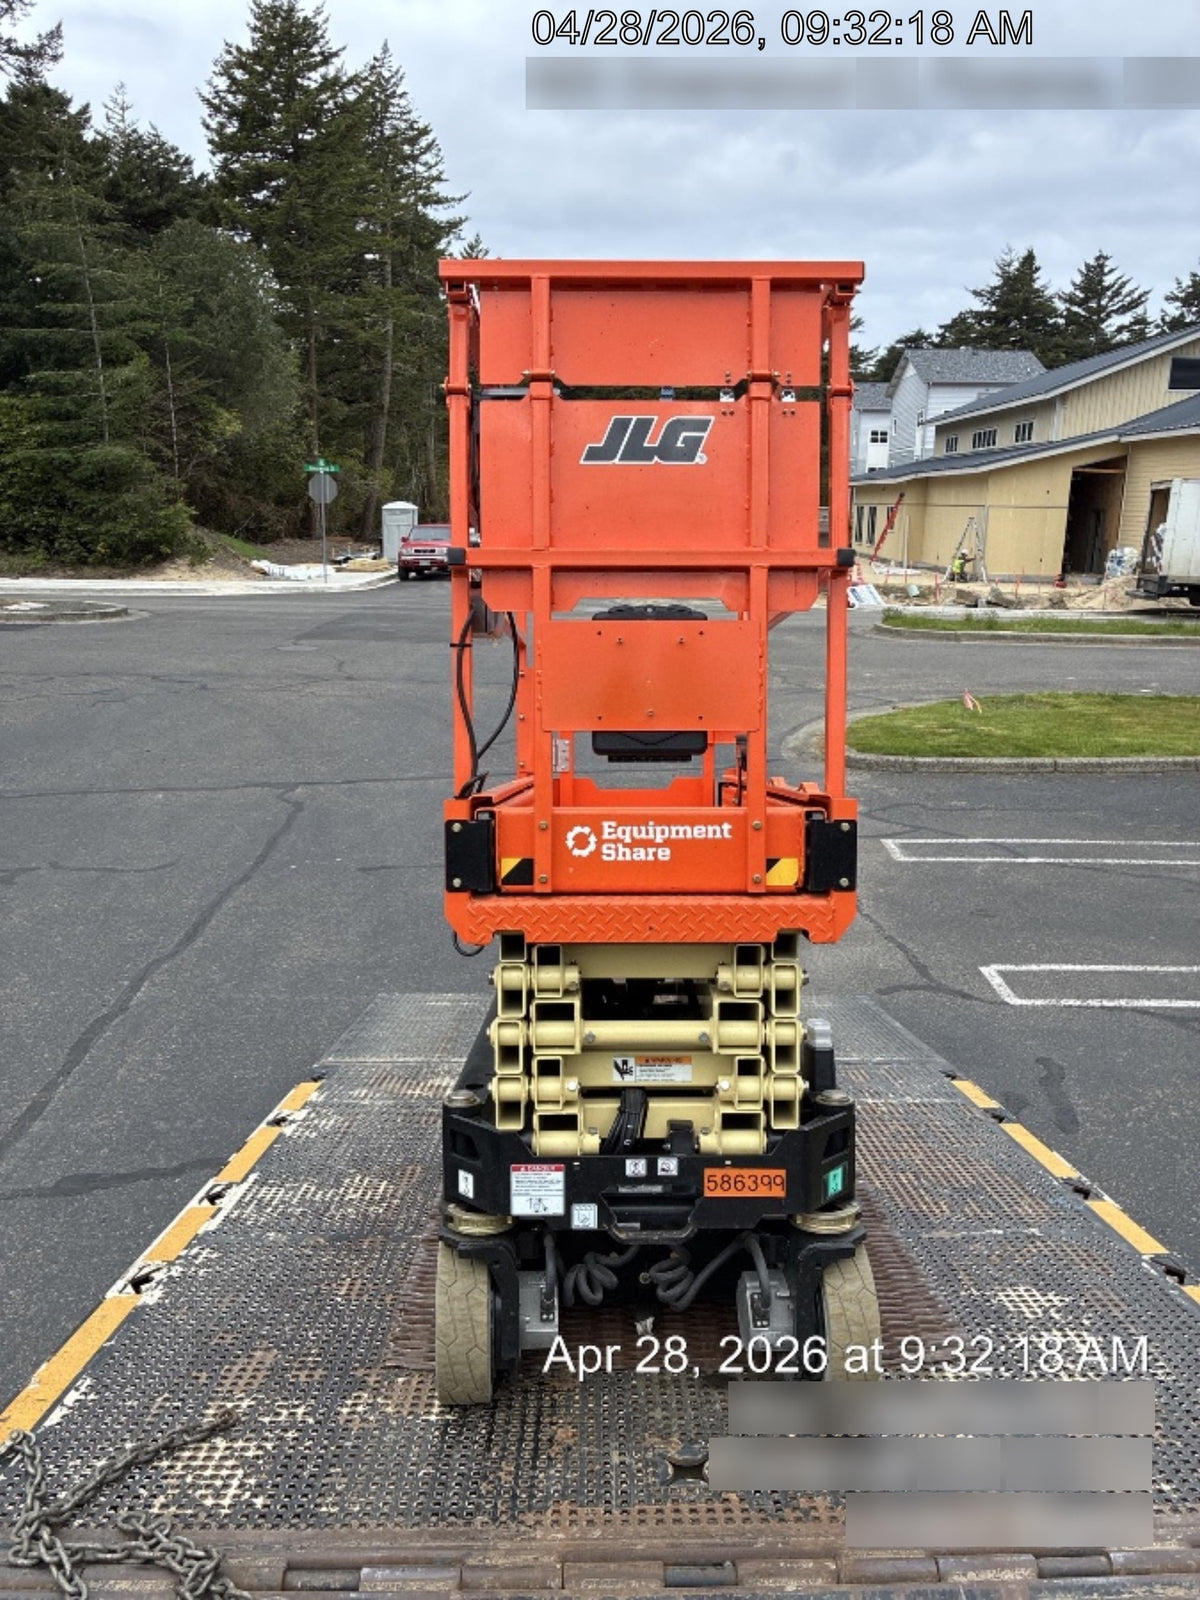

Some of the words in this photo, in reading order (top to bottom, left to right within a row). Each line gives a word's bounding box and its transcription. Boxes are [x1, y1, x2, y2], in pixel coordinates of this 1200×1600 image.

[579, 415, 715, 465] JLG
[601, 821, 732, 843] Equipment
[601, 843, 672, 861] Share
[706, 1174, 785, 1192] 586399
